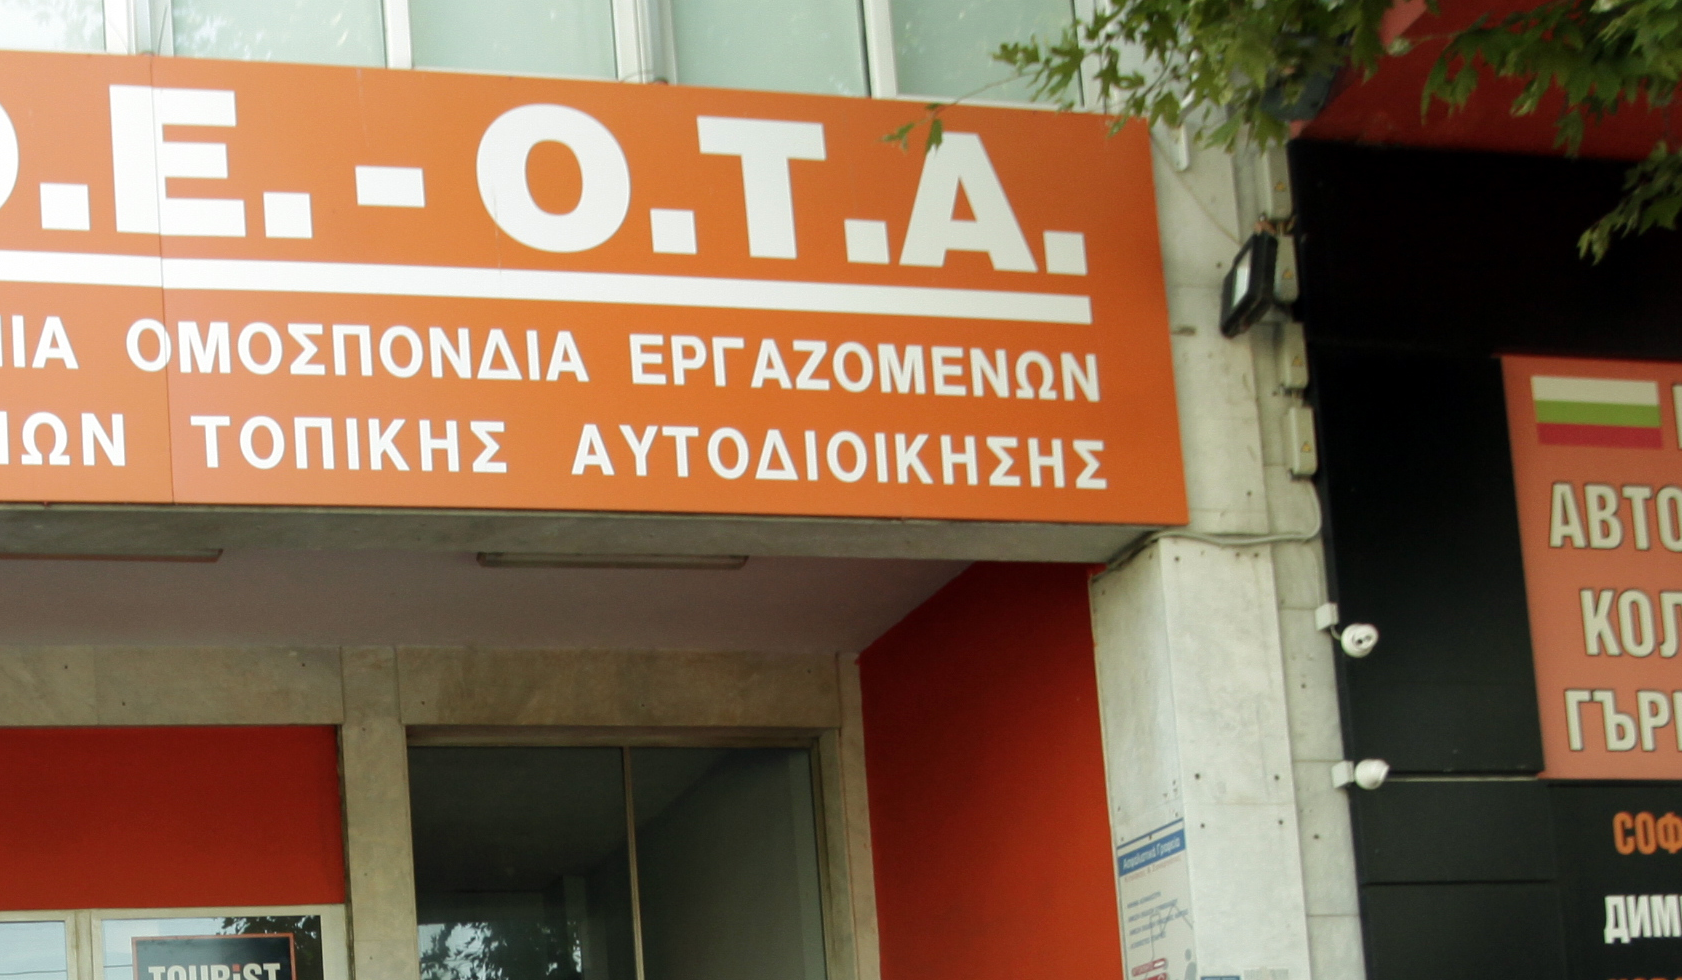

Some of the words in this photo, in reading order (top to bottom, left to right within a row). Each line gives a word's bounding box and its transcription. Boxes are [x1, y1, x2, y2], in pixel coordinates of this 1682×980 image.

[125, 317, 590, 383] ΟΜΟΣΠΟΝΔΙΑ
[629, 333, 1101, 403] ΕΡΓΑΖΟΜΕΝΩΝ
[190, 414, 508, 474] ΤΟΠΙΚΗΣ
[571, 423, 1108, 490] ΑΥΤΟΔΙΟΙΚΗΣΗΣ
[1564, 688, 1682, 753] ГЪР
[1603, 893, 1682, 945] ДИМ
